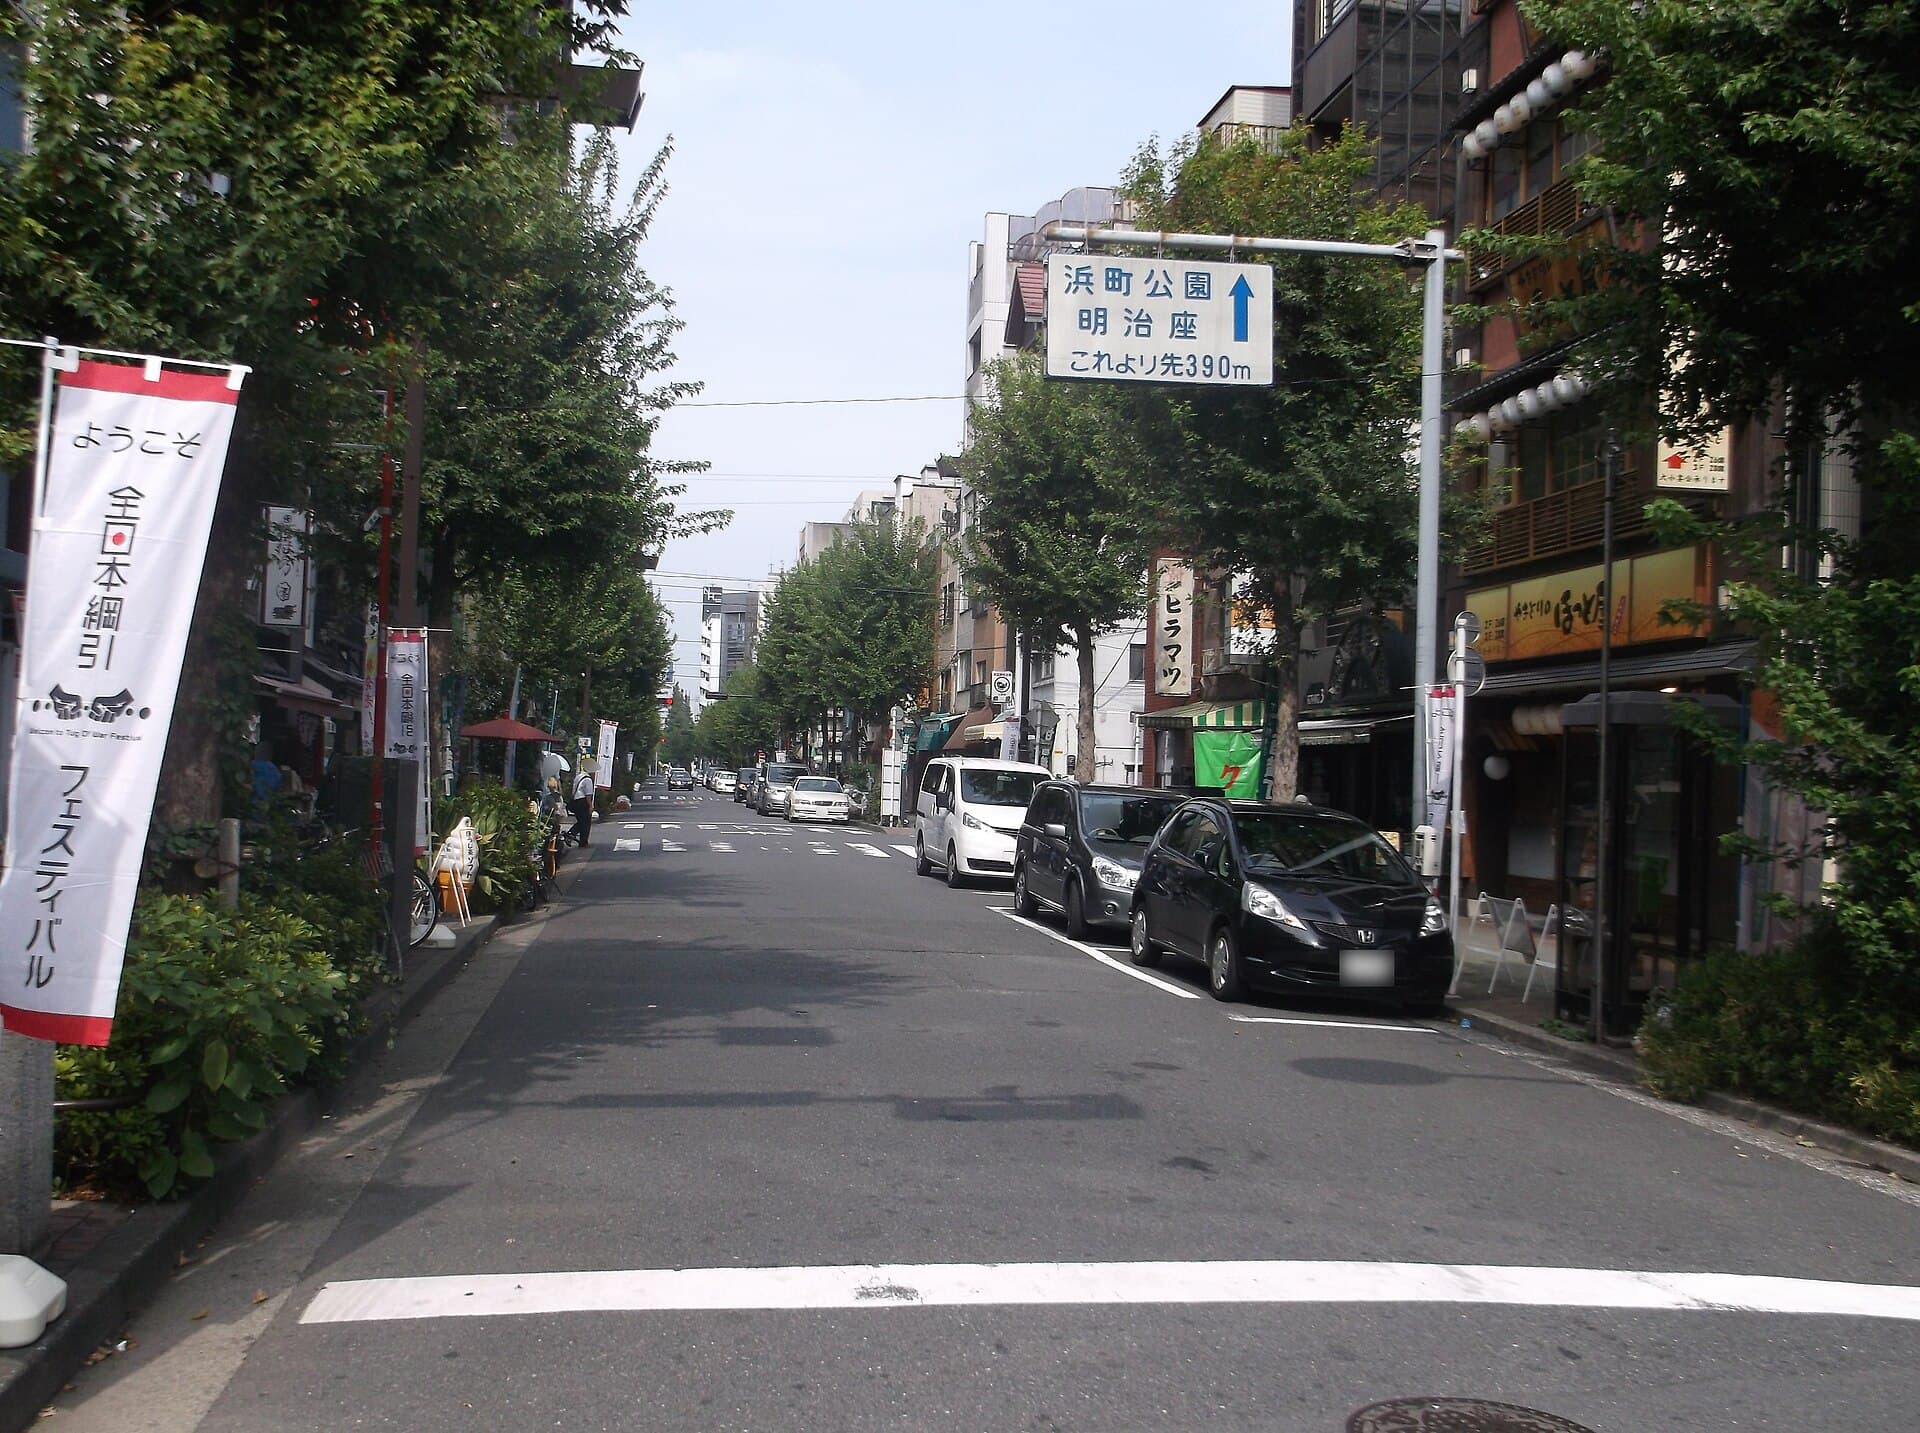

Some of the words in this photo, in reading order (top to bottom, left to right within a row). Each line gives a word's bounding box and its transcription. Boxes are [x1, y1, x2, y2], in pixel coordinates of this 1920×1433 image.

[1064, 264, 1212, 301] 浜町公園
[1078, 307, 1198, 341] 明治座
[1070, 350, 1251, 381] これより先390m
[72, 421, 203, 459] ようこそ
[78, 485, 146, 671] 全日本綱引
[1162, 593, 1182, 687] ヒラマツ
[25, 764, 90, 989] フェスティバル
